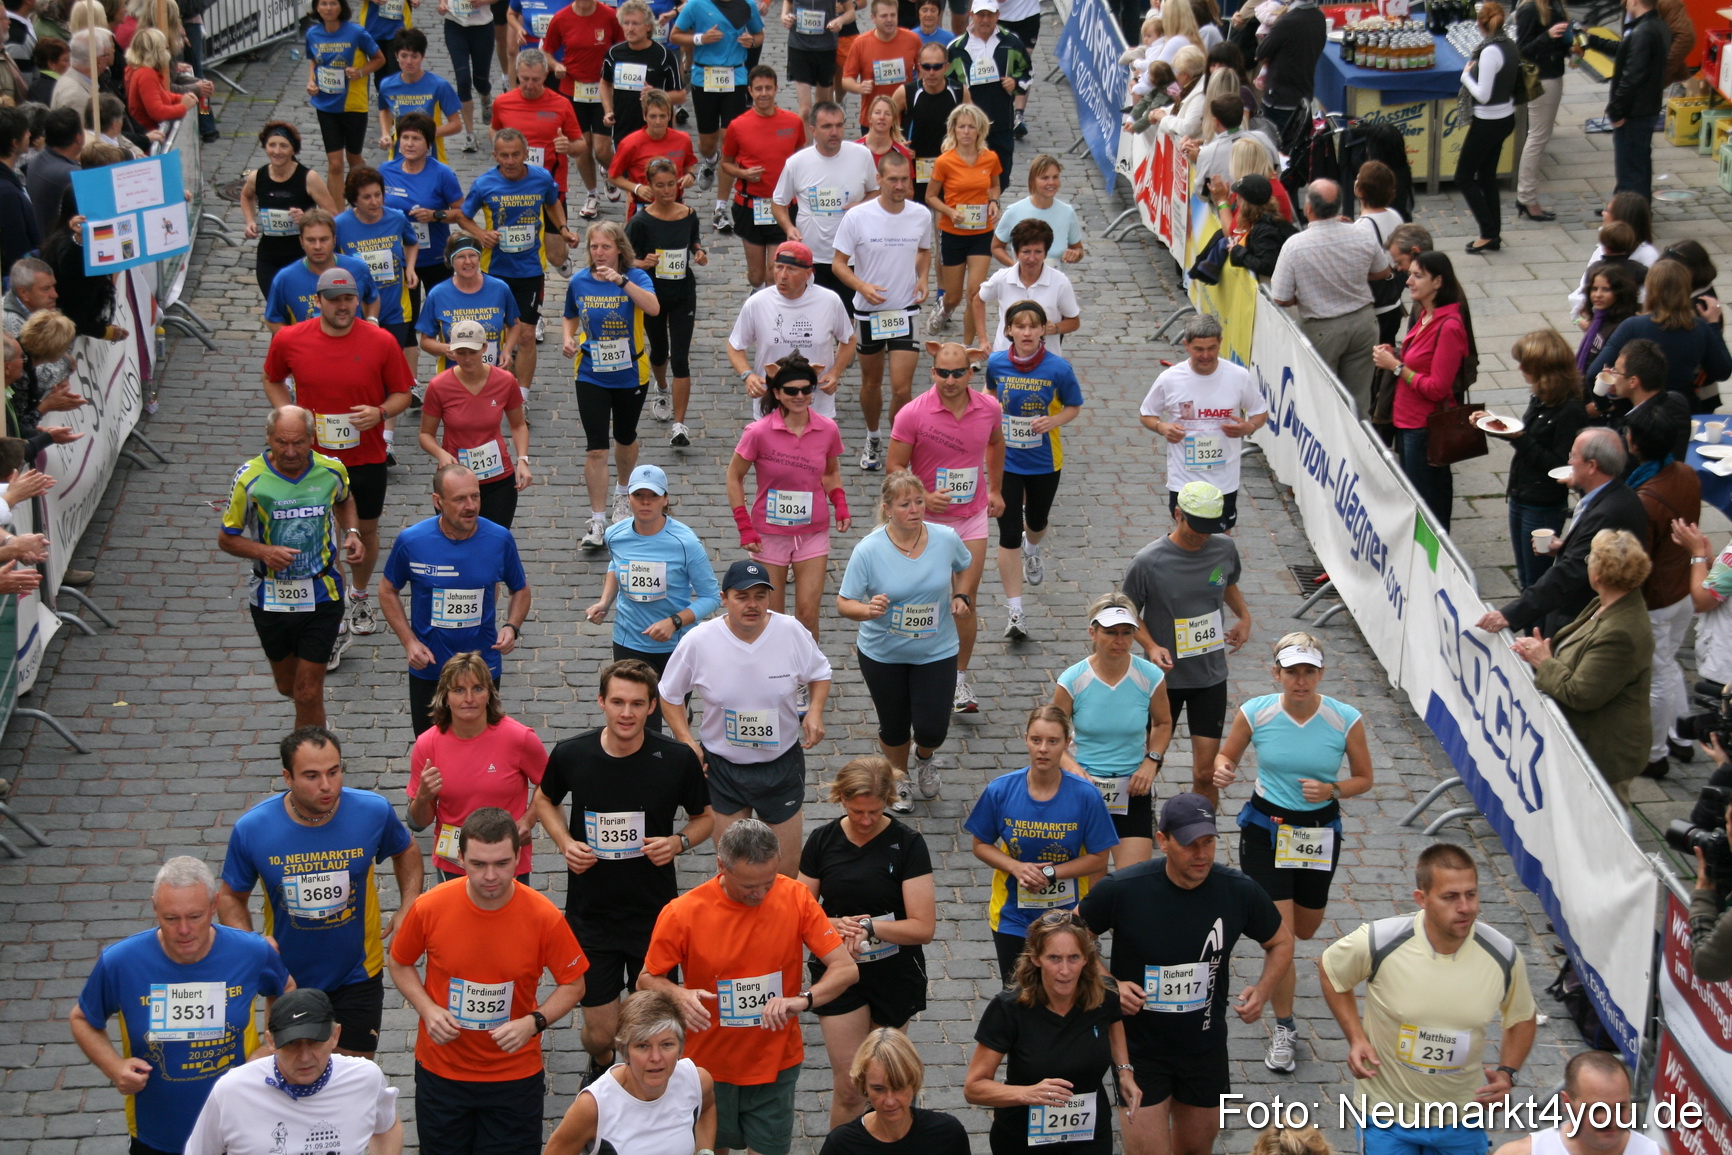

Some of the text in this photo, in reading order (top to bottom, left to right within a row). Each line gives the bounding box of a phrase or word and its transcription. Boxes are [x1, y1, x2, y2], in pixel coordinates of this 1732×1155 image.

[804, 17, 822, 25] 3603
[884, 69, 901, 77] 2811
[977, 67, 995, 77] 2999
[323, 77, 341, 86] 2694
[623, 74, 642, 83] 6024
[716, 76, 730, 84] 166
[586, 87, 598, 95] 167
[971, 212, 981, 221] 75
[272, 220, 294, 228] 2507
[509, 234, 532, 242] 2635
[357, 243, 394, 254] STADTLAUF
[669, 261, 685, 270] 466
[454, 308, 500, 316] NEUMARKTER
[453, 314, 493, 323] STADTLAUF
[881, 318, 905, 328] 3858
[602, 351, 626, 361] 2837
[1004, 383, 1041, 391] STADTLAUF
[1006, 377, 1052, 386] NEUMARKTER
[336, 428, 350, 438] 70
[1012, 428, 1037, 438] 3648
[470, 450, 485, 460] Tanja
[1198, 448, 1223, 460] 3322
[472, 454, 498, 470] 2137
[950, 481, 974, 491] 3667
[273, 506, 326, 519] BOCK
[779, 504, 806, 515] 3034
[632, 564, 650, 573] Sabine
[631, 575, 661, 588] 2834
[278, 589, 308, 599] 3203
[447, 592, 477, 602] Johannes
[447, 603, 477, 615] 2835
[905, 606, 934, 615] Alexandra
[904, 616, 934, 627] 2908
[1188, 619, 1209, 631] Martin
[1194, 626, 1216, 643] 648
[1434, 588, 1544, 814] BOCK
[739, 715, 758, 723] Franz
[741, 725, 774, 738] 2338
[1094, 781, 1115, 790] erstin
[1103, 792, 1120, 802] 47
[599, 816, 626, 828] Florian
[1004, 817, 1078, 832] 10. NEUMARKTER
[601, 829, 639, 843] 3358
[1012, 829, 1065, 840] STADTLAUF
[1292, 830, 1311, 840] Hilde
[1295, 843, 1323, 855] 464
[269, 848, 364, 868] 10. NEUMARKTER
[284, 860, 350, 875] STADTLAUF
[301, 872, 331, 884] Markus
[303, 886, 343, 902] 3689
[1672, 910, 1690, 949] Wir
[1675, 952, 1688, 983] im
[1163, 968, 1194, 980] Richard
[466, 986, 507, 997] Ferdinand
[736, 981, 760, 994] Georg
[1163, 982, 1203, 996] 3117
[1202, 955, 1221, 1031] RAIL.ONE
[171, 989, 203, 999] Hubert
[172, 1004, 216, 1020] 3531
[466, 999, 507, 1014] 3352
[1418, 1031, 1457, 1046] Matthias
[189, 1042, 236, 1060] 20.09.2009
[1422, 1046, 1454, 1062] 231
[1664, 1051, 1687, 1092] Wir
[1047, 1112, 1090, 1128] 2167
[305, 1140, 341, 1151] 21.09.2008
